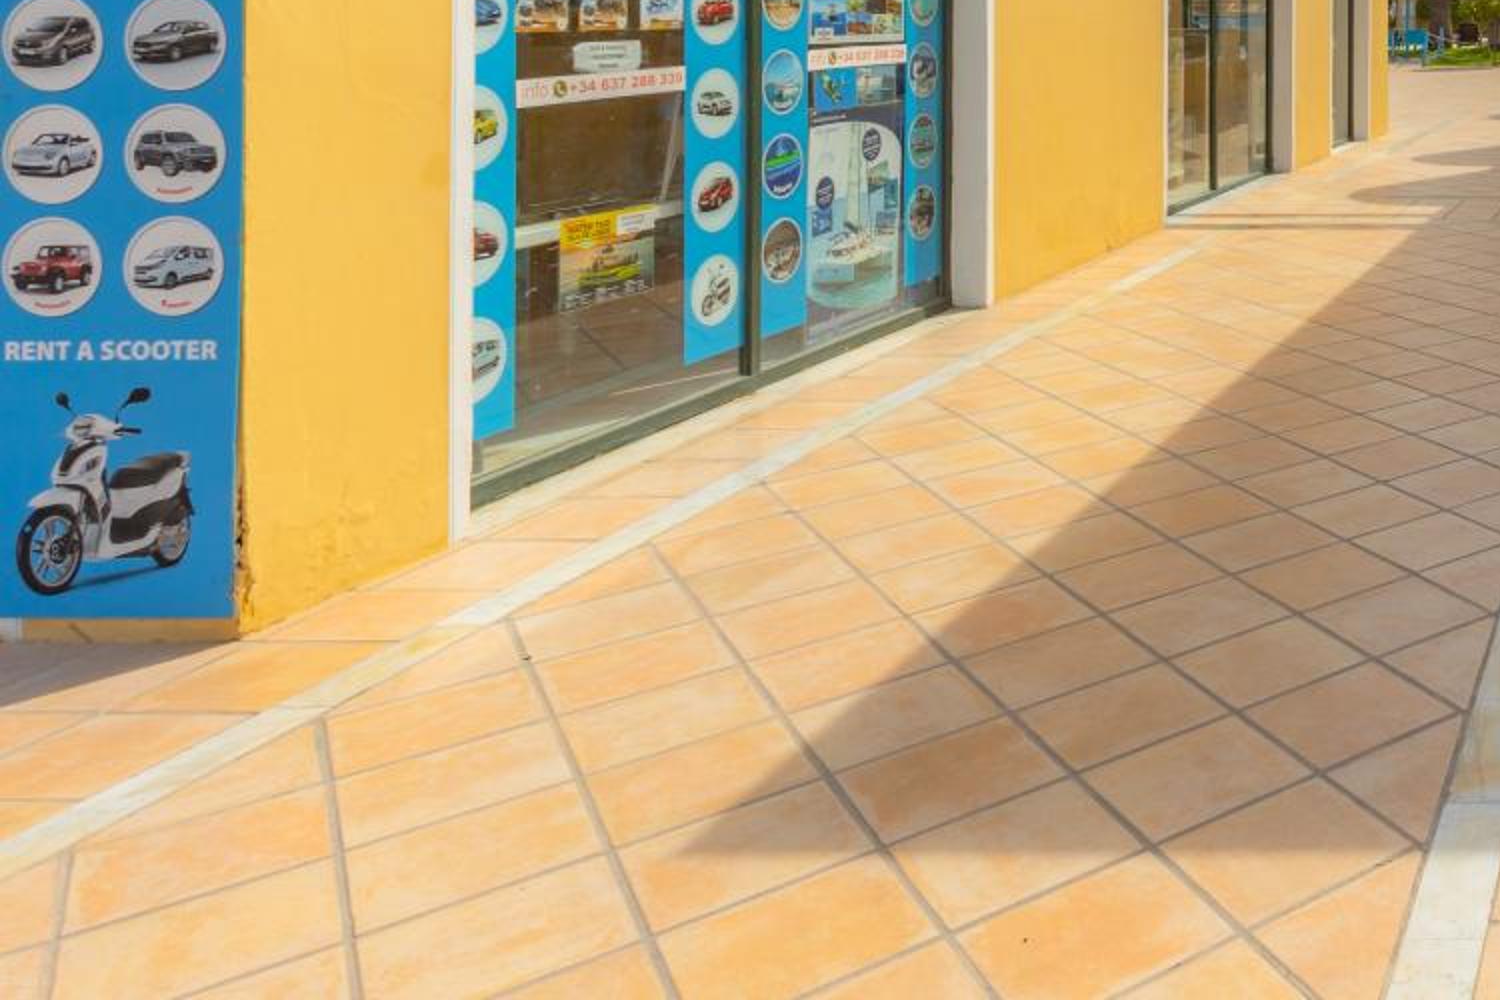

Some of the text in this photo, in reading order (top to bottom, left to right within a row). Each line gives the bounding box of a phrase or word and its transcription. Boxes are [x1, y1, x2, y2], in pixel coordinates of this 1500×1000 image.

[4, 339, 218, 361] RENT A SCOOTER
